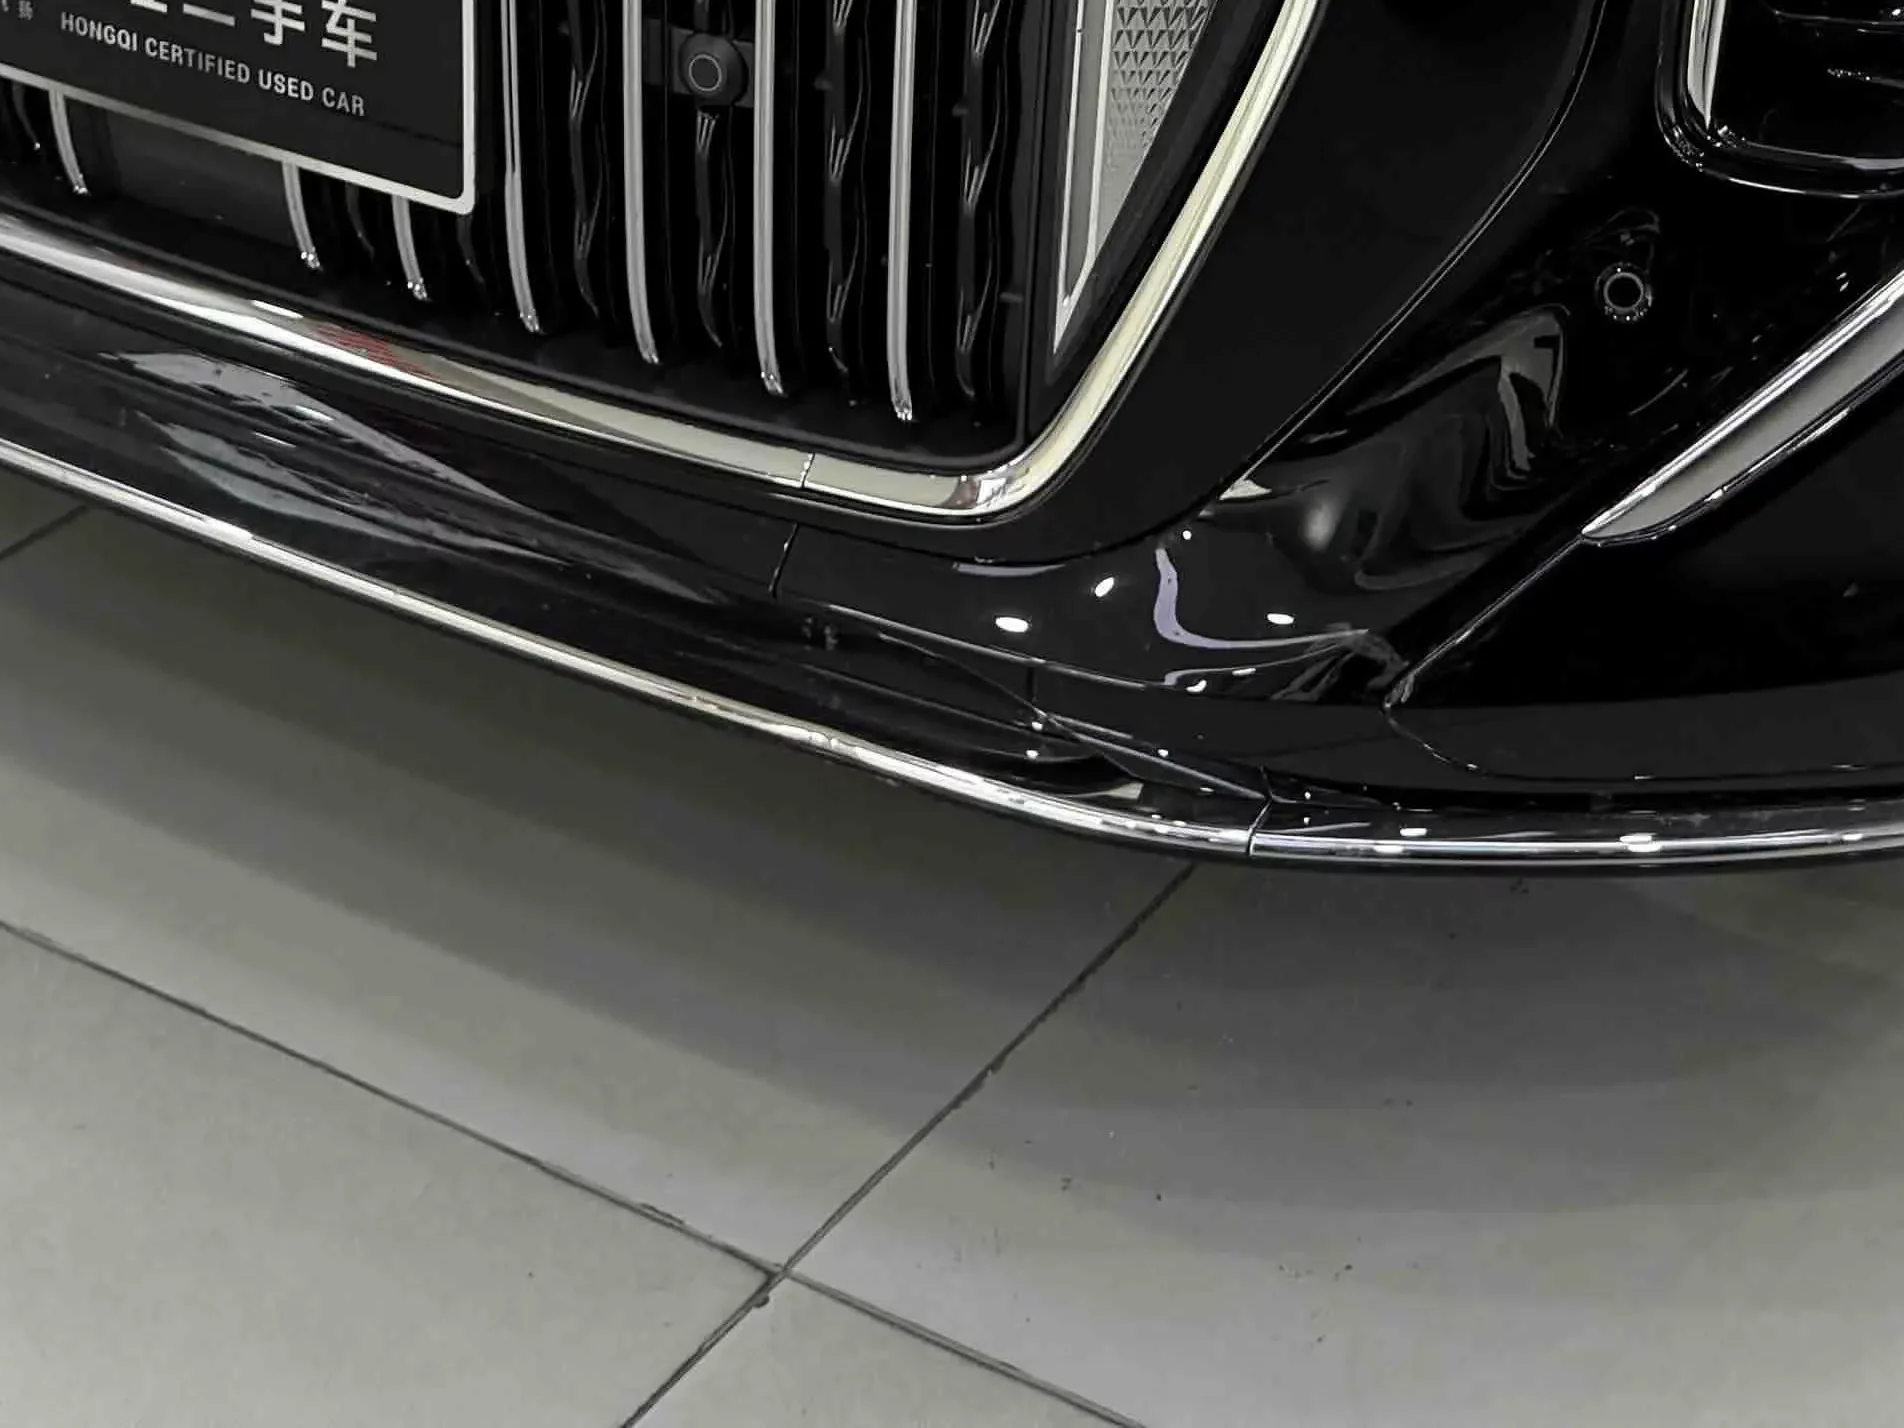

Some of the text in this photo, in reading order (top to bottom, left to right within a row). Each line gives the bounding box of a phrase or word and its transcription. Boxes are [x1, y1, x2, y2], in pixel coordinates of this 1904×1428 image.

[61, 11, 365, 117] HONGQI CERTIFIED USED CAR
